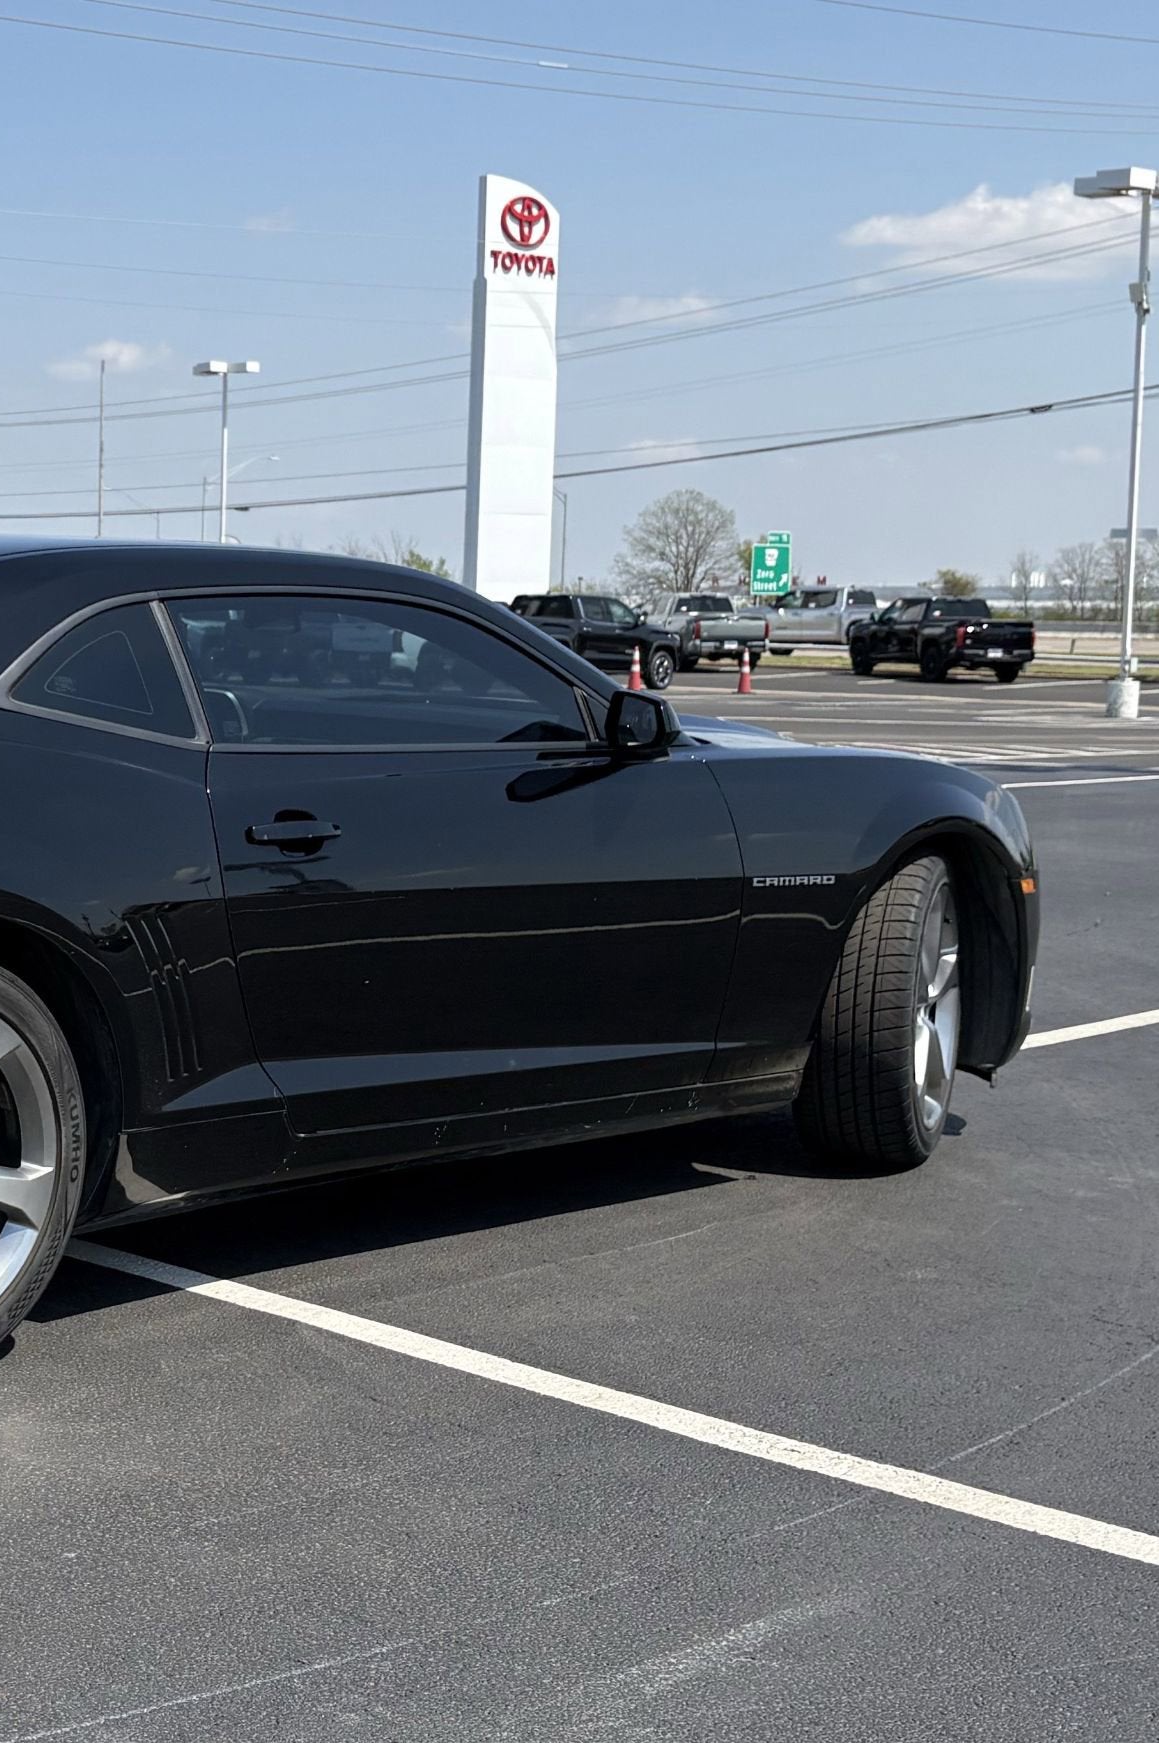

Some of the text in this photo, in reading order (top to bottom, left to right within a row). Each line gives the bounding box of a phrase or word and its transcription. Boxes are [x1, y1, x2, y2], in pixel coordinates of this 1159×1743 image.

[490, 250, 556, 279] TOYOTA
[753, 581, 777, 592] Street
[752, 875, 836, 888] CAMARO
[66, 1087, 81, 1183] KUMHO
